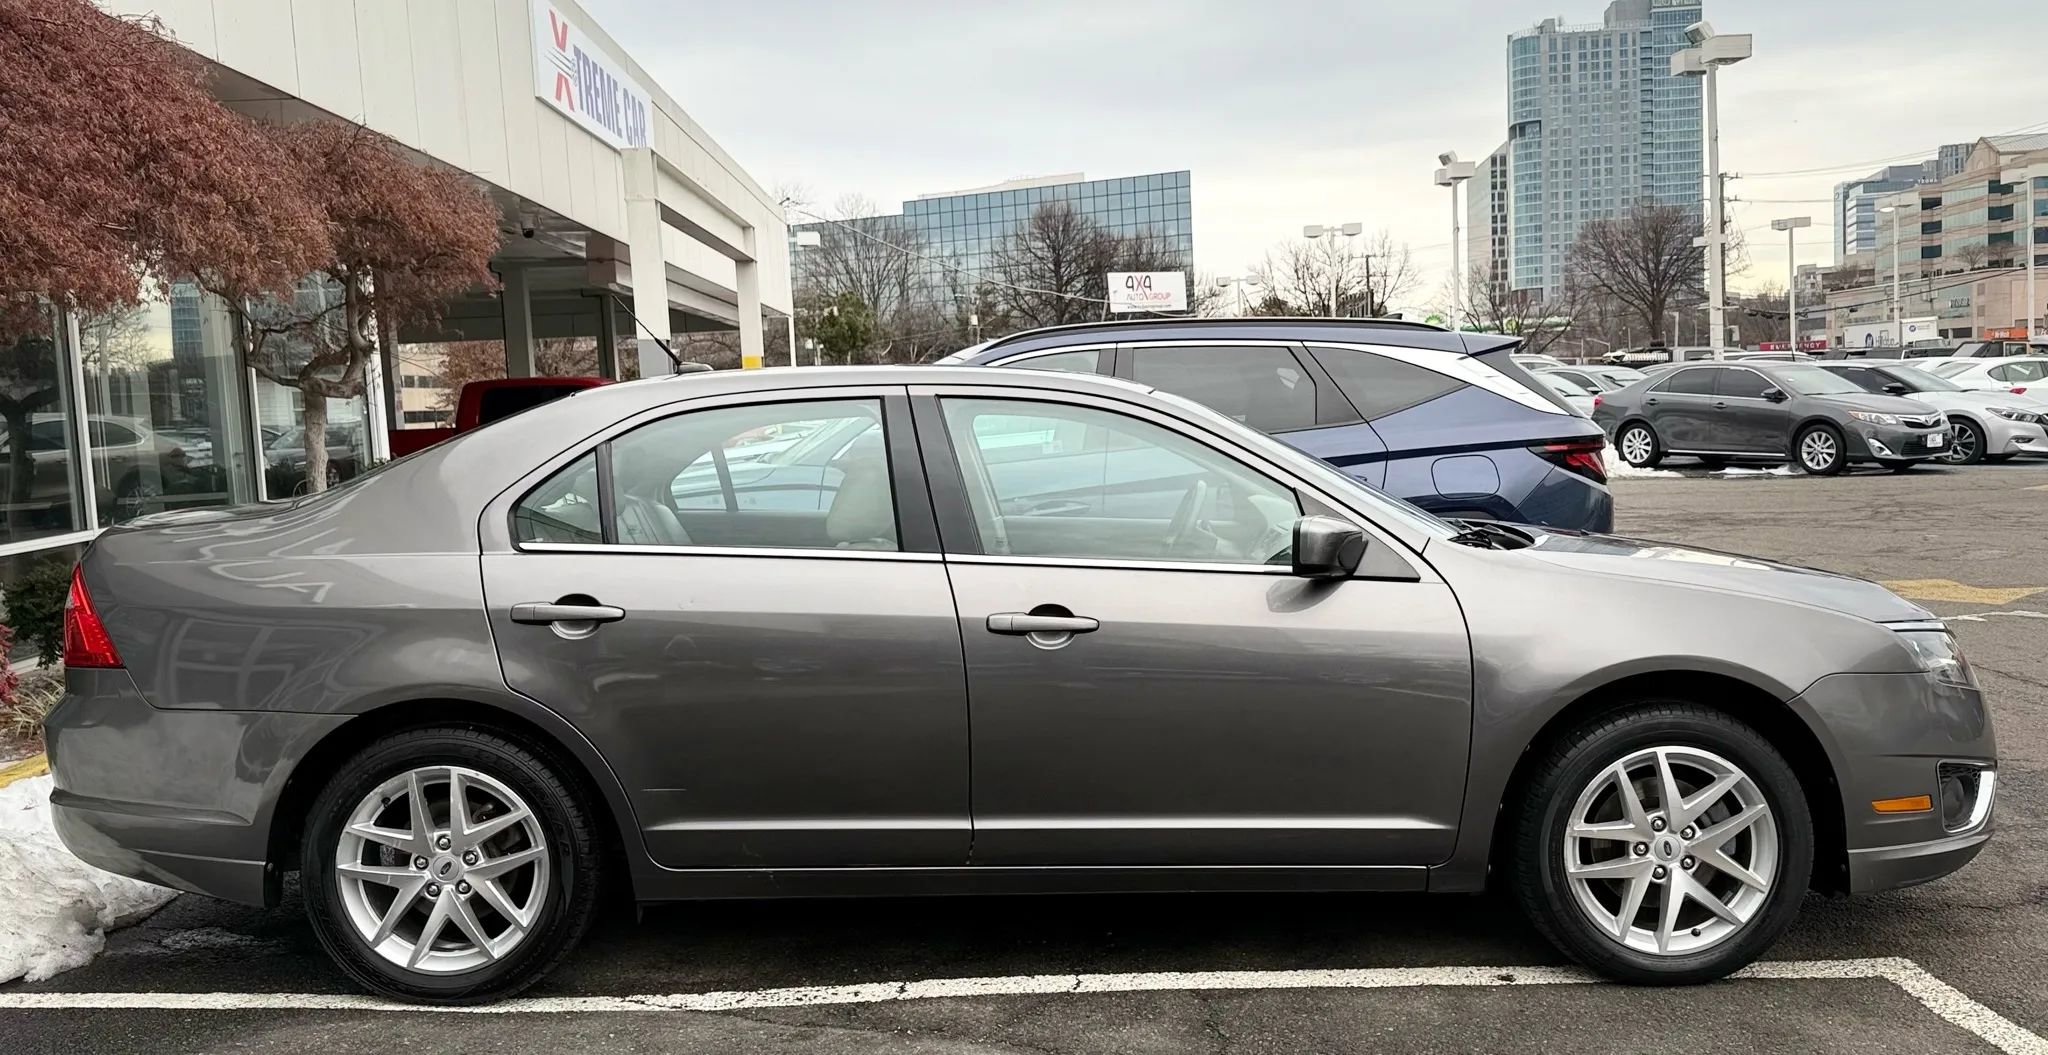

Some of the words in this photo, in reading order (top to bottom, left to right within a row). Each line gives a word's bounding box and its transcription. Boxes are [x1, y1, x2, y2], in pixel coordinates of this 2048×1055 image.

[623, 88, 647, 149] CAR
[1127, 293, 1144, 301] AUTO
[1149, 292, 1171, 301] GROUP
